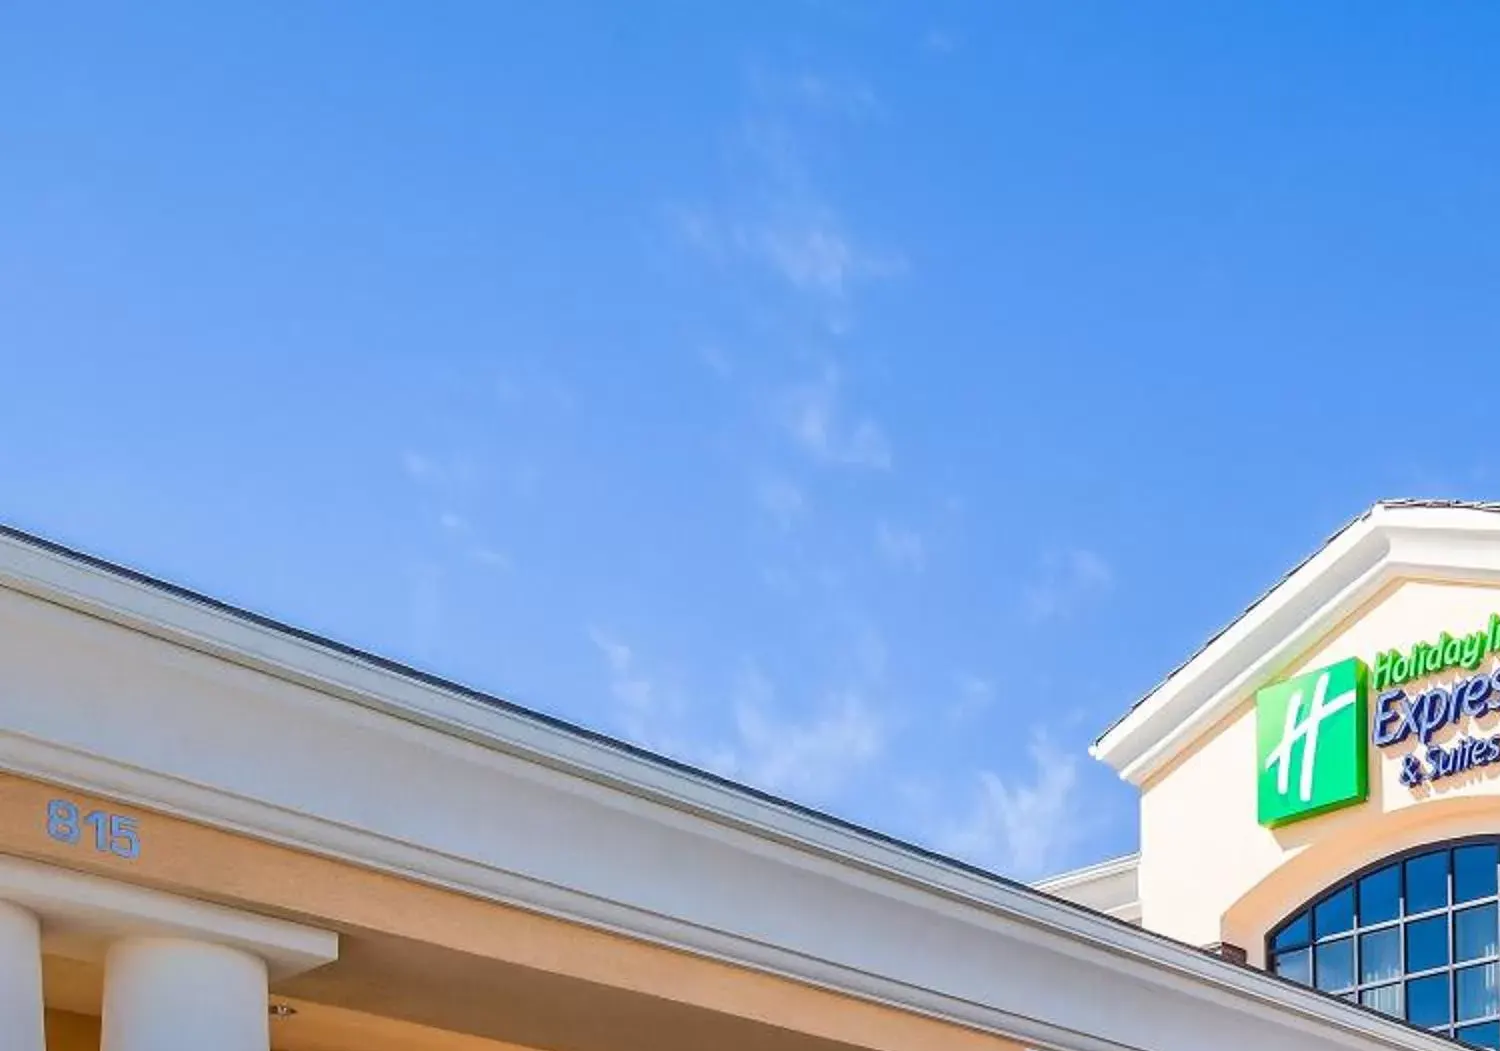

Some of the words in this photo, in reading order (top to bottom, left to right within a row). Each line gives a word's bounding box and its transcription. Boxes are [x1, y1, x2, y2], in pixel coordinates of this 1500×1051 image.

[1373, 631, 1487, 690] Holiday
[1400, 753, 1422, 788] &
[47, 799, 141, 860] 815
